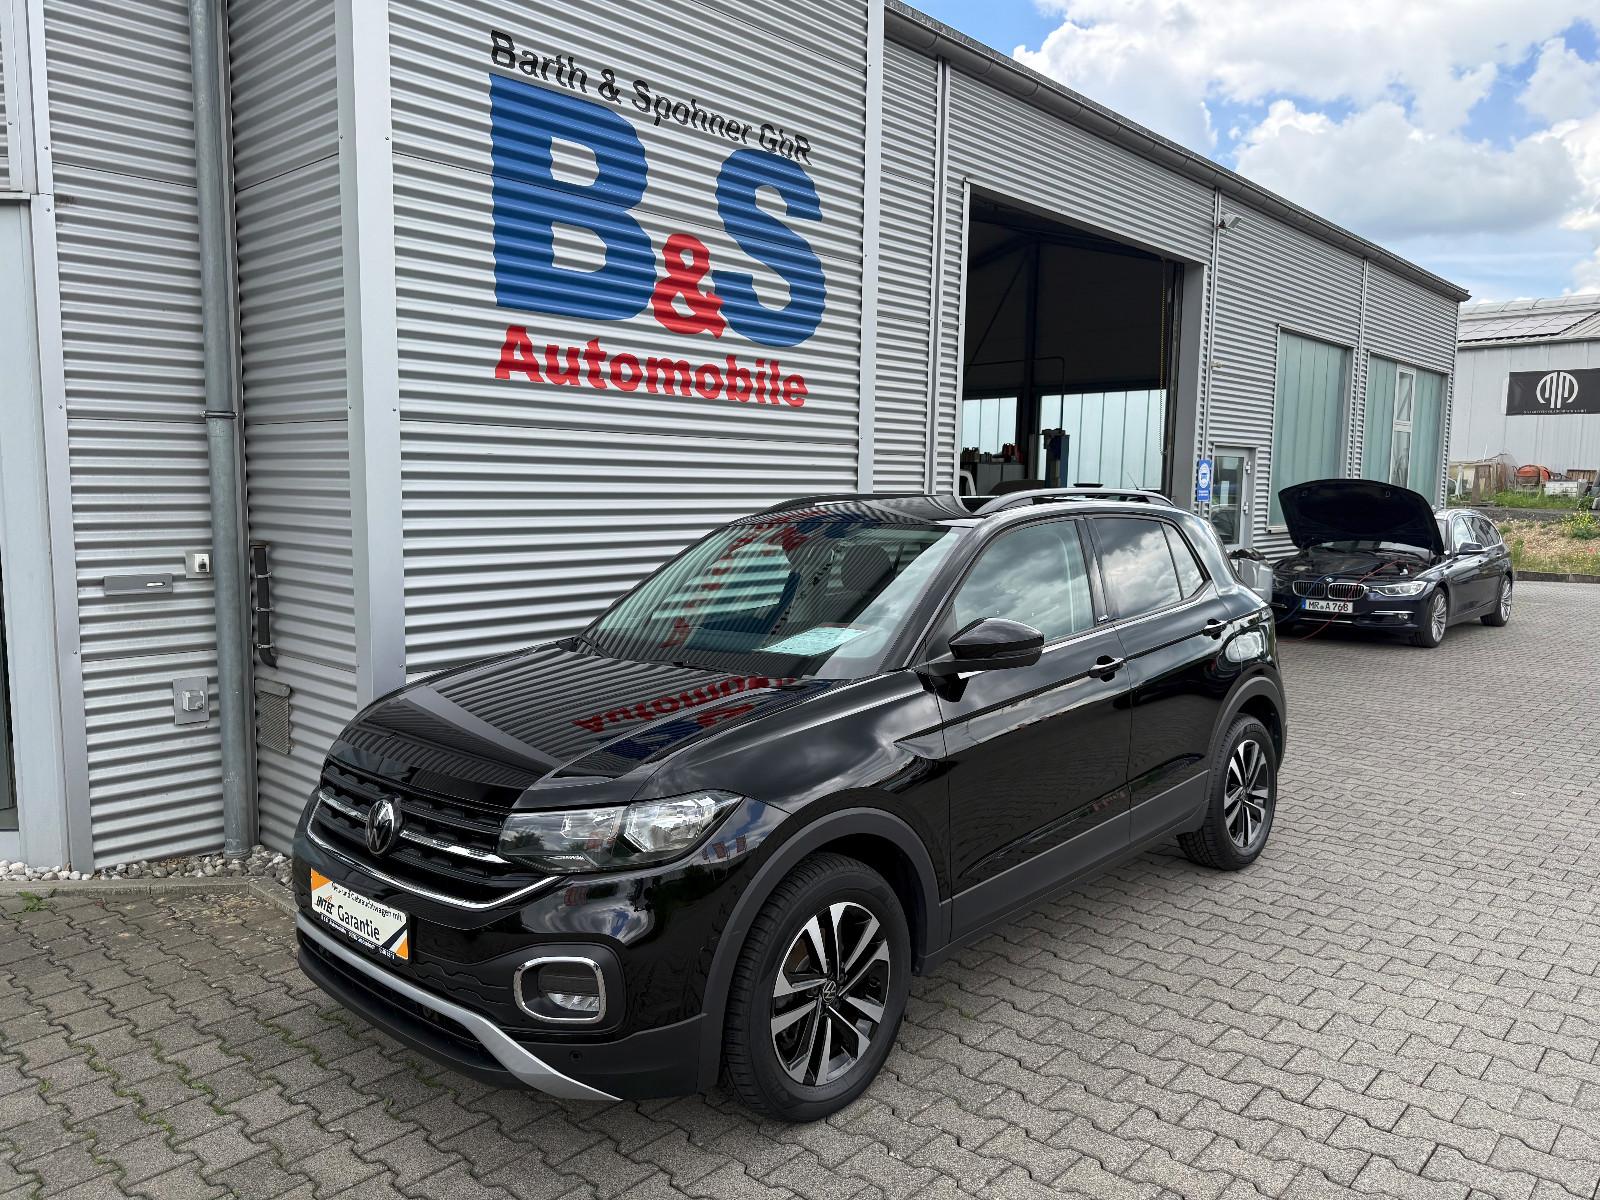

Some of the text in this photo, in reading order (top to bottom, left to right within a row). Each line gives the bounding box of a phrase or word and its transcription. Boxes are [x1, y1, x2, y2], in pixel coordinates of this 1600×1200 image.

[491, 30, 812, 166] Barth & Spohner GbR
[495, 324, 808, 407] Automobile
[337, 904, 381, 942] Garantie
